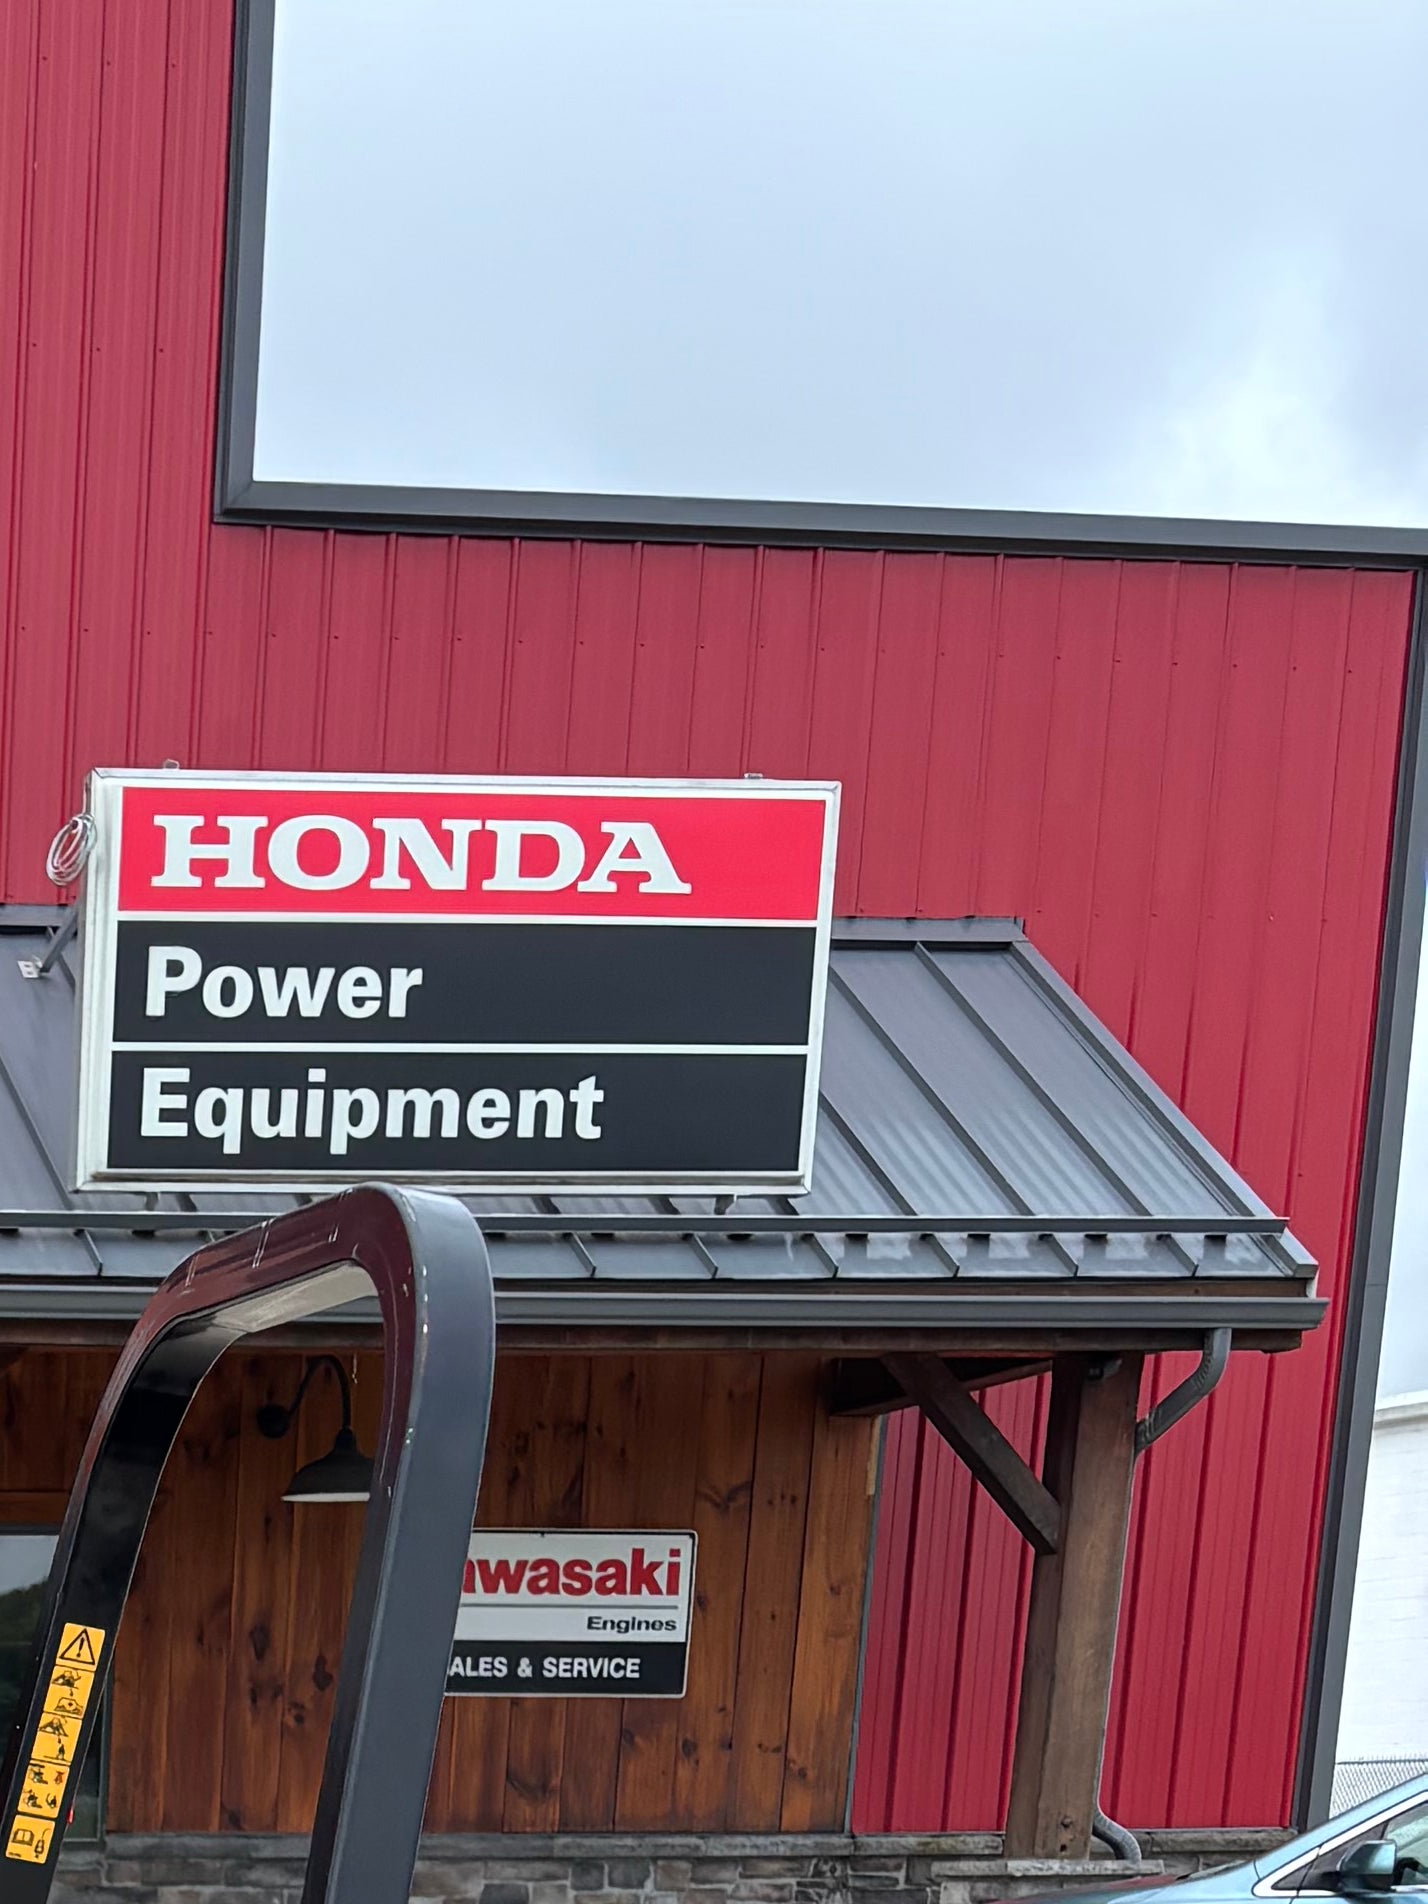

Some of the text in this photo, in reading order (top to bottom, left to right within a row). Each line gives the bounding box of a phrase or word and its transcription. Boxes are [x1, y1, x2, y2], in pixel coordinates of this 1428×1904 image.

[150, 813, 692, 896] HONDA
[144, 944, 424, 1018] Power
[140, 1066, 605, 1156] Equipment
[461, 1547, 682, 1597] wasaki
[586, 1615, 678, 1634] Engines
[449, 1655, 642, 1679] ALES & SERVICE
